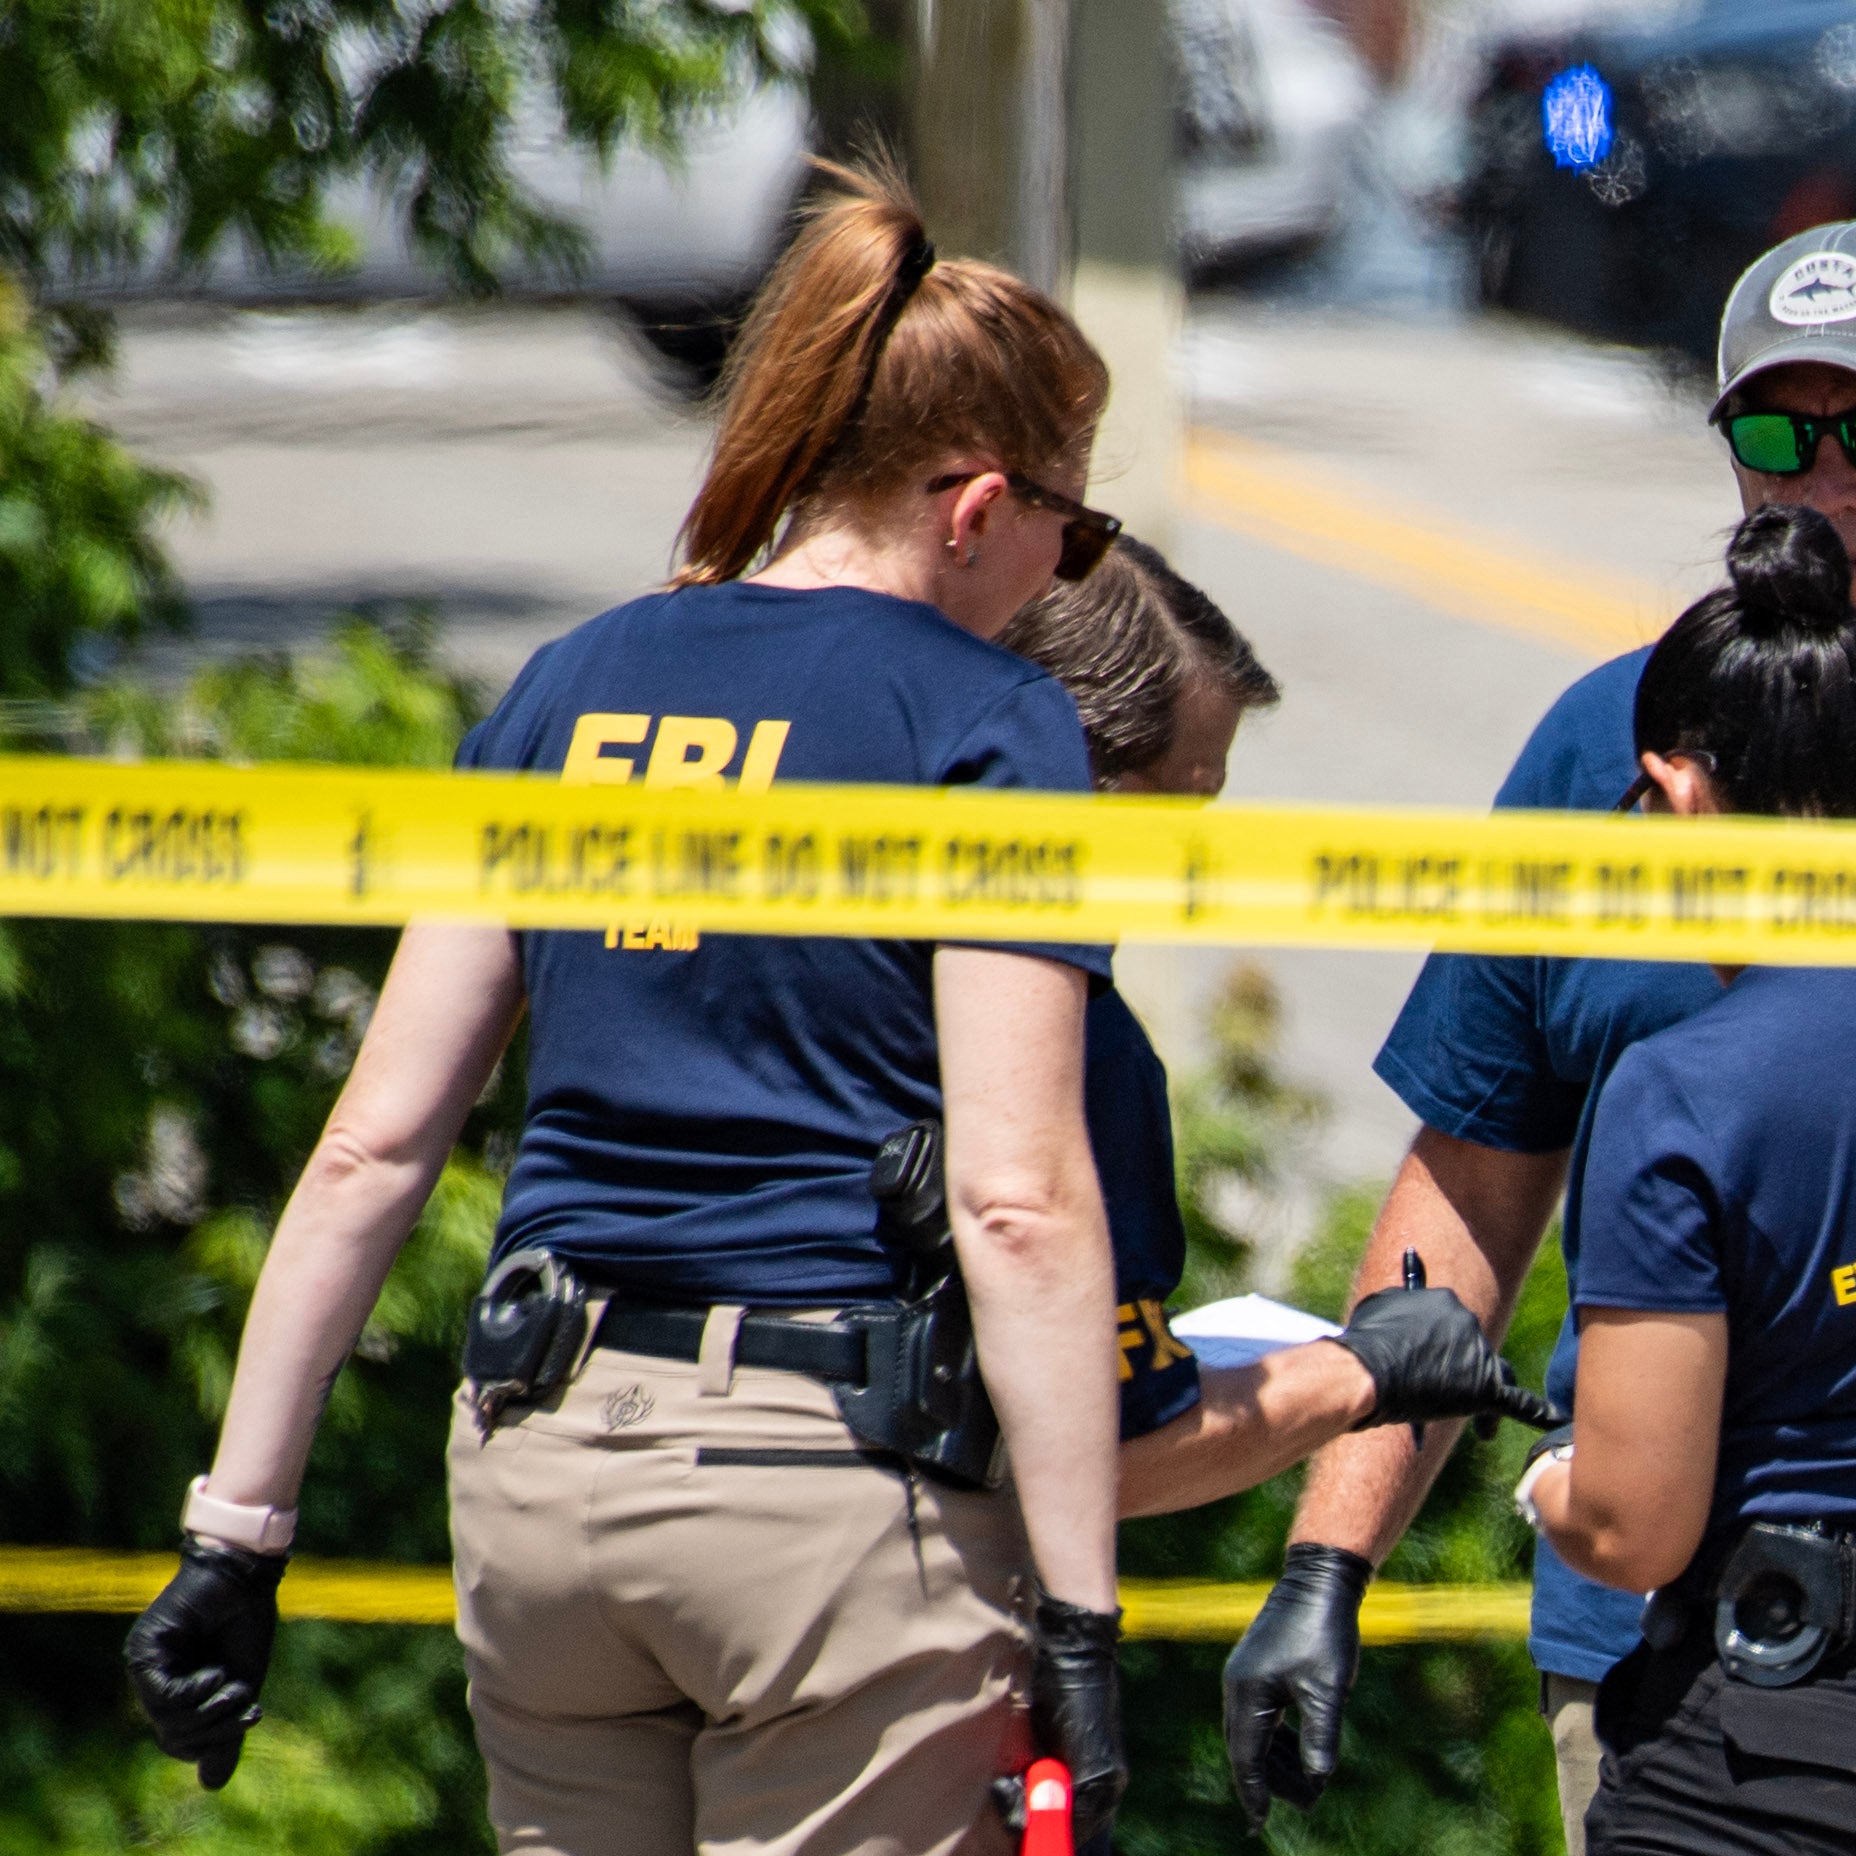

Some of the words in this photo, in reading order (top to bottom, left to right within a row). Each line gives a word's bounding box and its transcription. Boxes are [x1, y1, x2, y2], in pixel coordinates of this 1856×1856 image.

[2, 804, 84, 880] NOT
[100, 804, 248, 884] CROSS
[480, 824, 635, 898] POLICE
[649, 829, 743, 901] LINE
[763, 834, 820, 903] DO
[838, 836, 922, 907] NOT
[941, 839, 1081, 911] CROSS
[1311, 854, 1461, 922] POLICE
[1479, 858, 1572, 927] LINE
[1594, 860, 1646, 929] DO
[1670, 864, 1748, 931] NOT
[603, 914, 700, 951] TEAM
